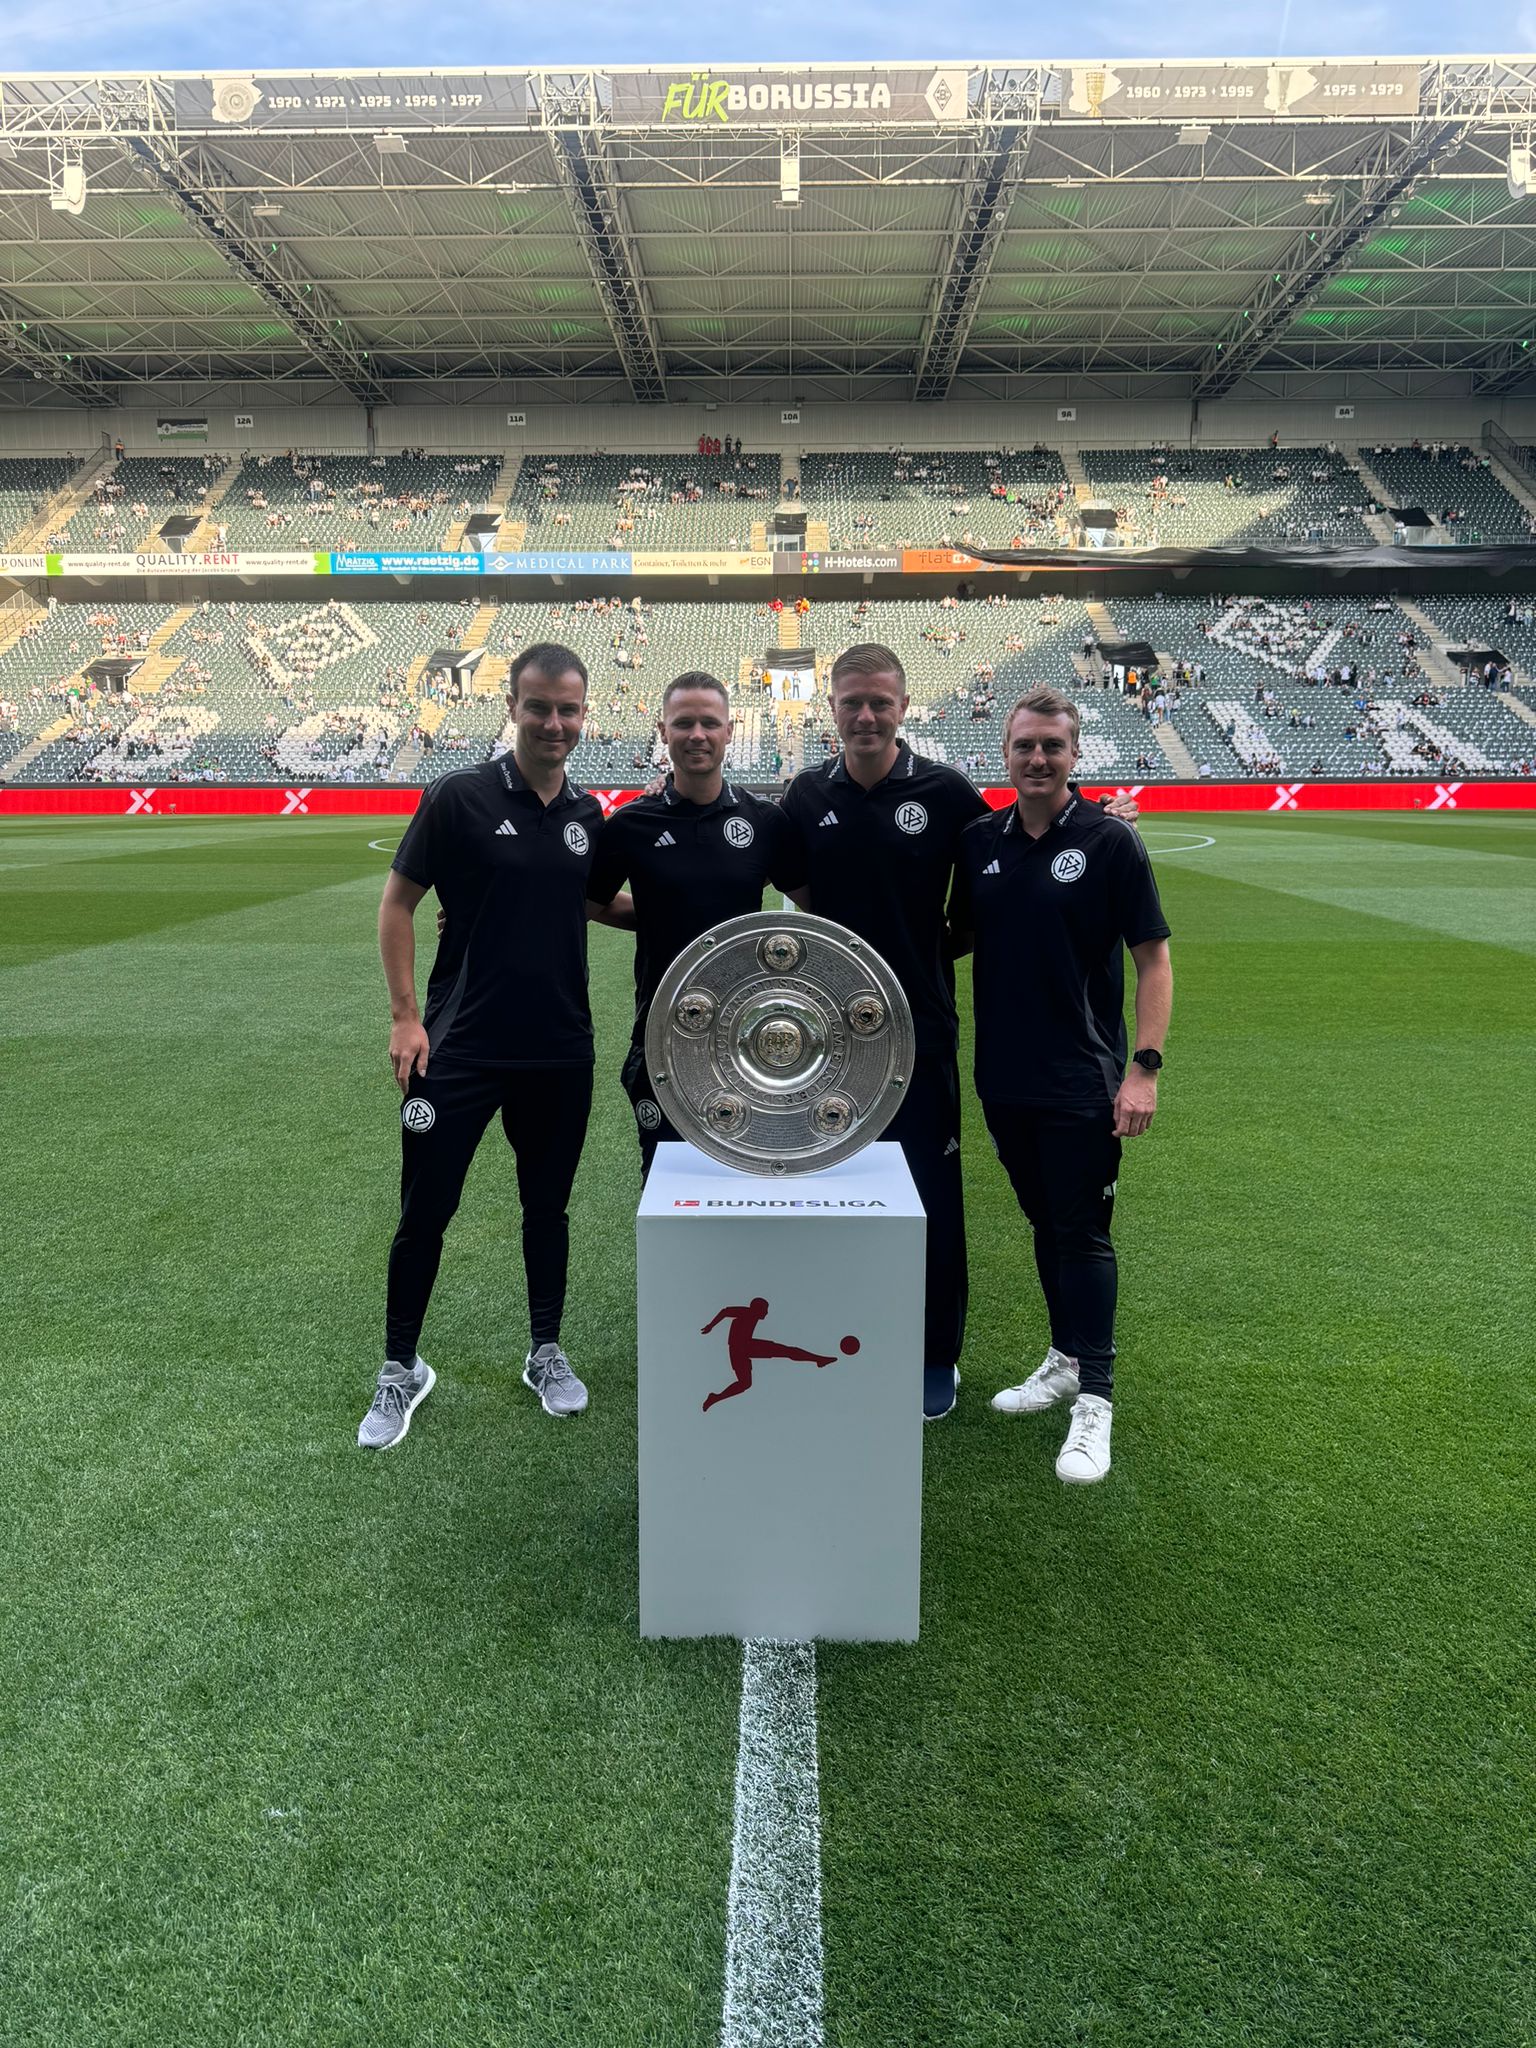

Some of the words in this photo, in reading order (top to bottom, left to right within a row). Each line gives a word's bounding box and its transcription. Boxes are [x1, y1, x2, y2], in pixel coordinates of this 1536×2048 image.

[1126, 86, 1161, 98] 1960
[1174, 86, 1206, 98] 1973
[1220, 85, 1254, 98] 1995
[1323, 84, 1356, 96] 1975
[1370, 83, 1403, 96] 1979
[268, 96, 301, 109] 1970
[315, 96, 346, 108] 1971
[359, 95, 391, 107] 1975
[405, 95, 437, 107] 1976
[451, 94, 482, 107] 1977
[661, 72, 729, 122] FÜR
[727, 83, 891, 110] BORUSSIA
[1061, 410, 1072, 418] 9A
[237, 417, 251, 425] 12A
[10, 558, 45, 568] ONLINE
[68, 560, 130, 568] www.quality-rent.de
[136, 554, 239, 567] QUALITY.RENT
[381, 555, 479, 567] www.raetzig.de
[516, 558, 585, 569] MEDICAL
[592, 558, 630, 569] PARK
[750, 556, 771, 566] EGN
[824, 556, 898, 567] H-Hotels.com
[706, 1200, 888, 1208] BUNDESLIGA
